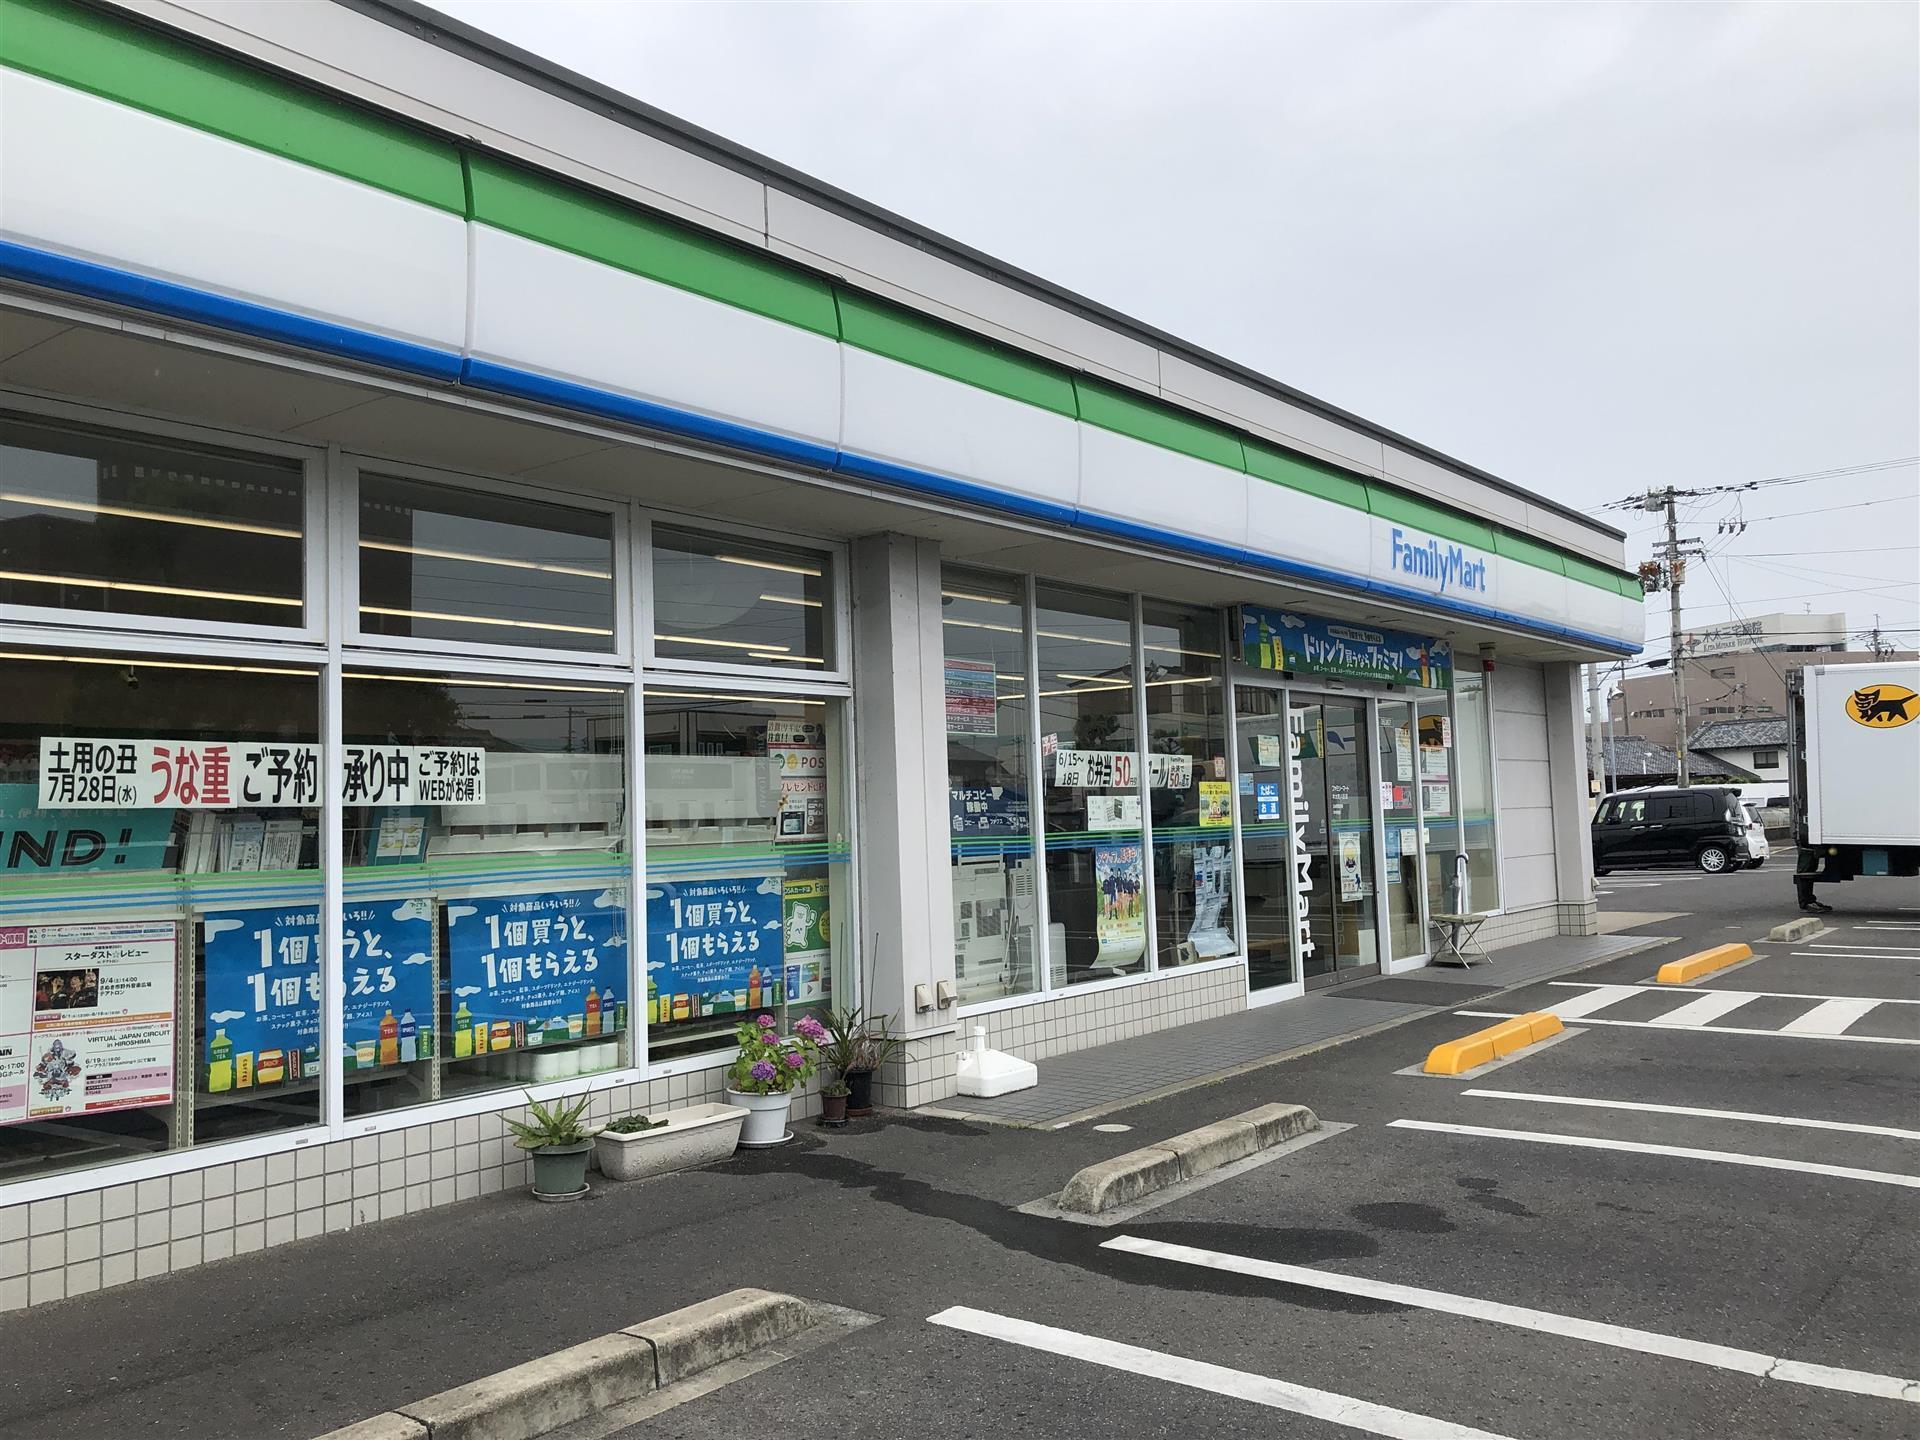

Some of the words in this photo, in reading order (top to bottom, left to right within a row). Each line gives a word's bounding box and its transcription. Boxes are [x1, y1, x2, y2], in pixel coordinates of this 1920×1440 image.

[1392, 528, 1486, 592] FamilyMart
[48, 742, 137, 774] 土用の丑
[419, 750, 480, 776] ご予約は
[1087, 753, 1112, 786] お弁当
[1115, 755, 1131, 787] 50
[1149, 756, 1168, 786] ール
[48, 774, 137, 805] 7月28日(水)
[152, 746, 231, 804] うな重
[243, 747, 317, 803] ご予約
[342, 749, 409, 803] 承り中
[419, 777, 481, 802] WEBがお得!
[1062, 771, 1080, 786] 18日
[0, 828, 133, 868] ND!
[1289, 708, 1315, 958] FamilyMart
[670, 898, 757, 929] 1個買うと、
[485, 914, 594, 949] 1個買うと、
[666, 930, 760, 963] 1個もらえる
[481, 948, 599, 989] 1個もらえる
[88, 1035, 117, 1043] VIRTUAL
[143, 1030, 171, 1038] CIRCUIT
[114, 1038, 151, 1047] HIROSHIMA
